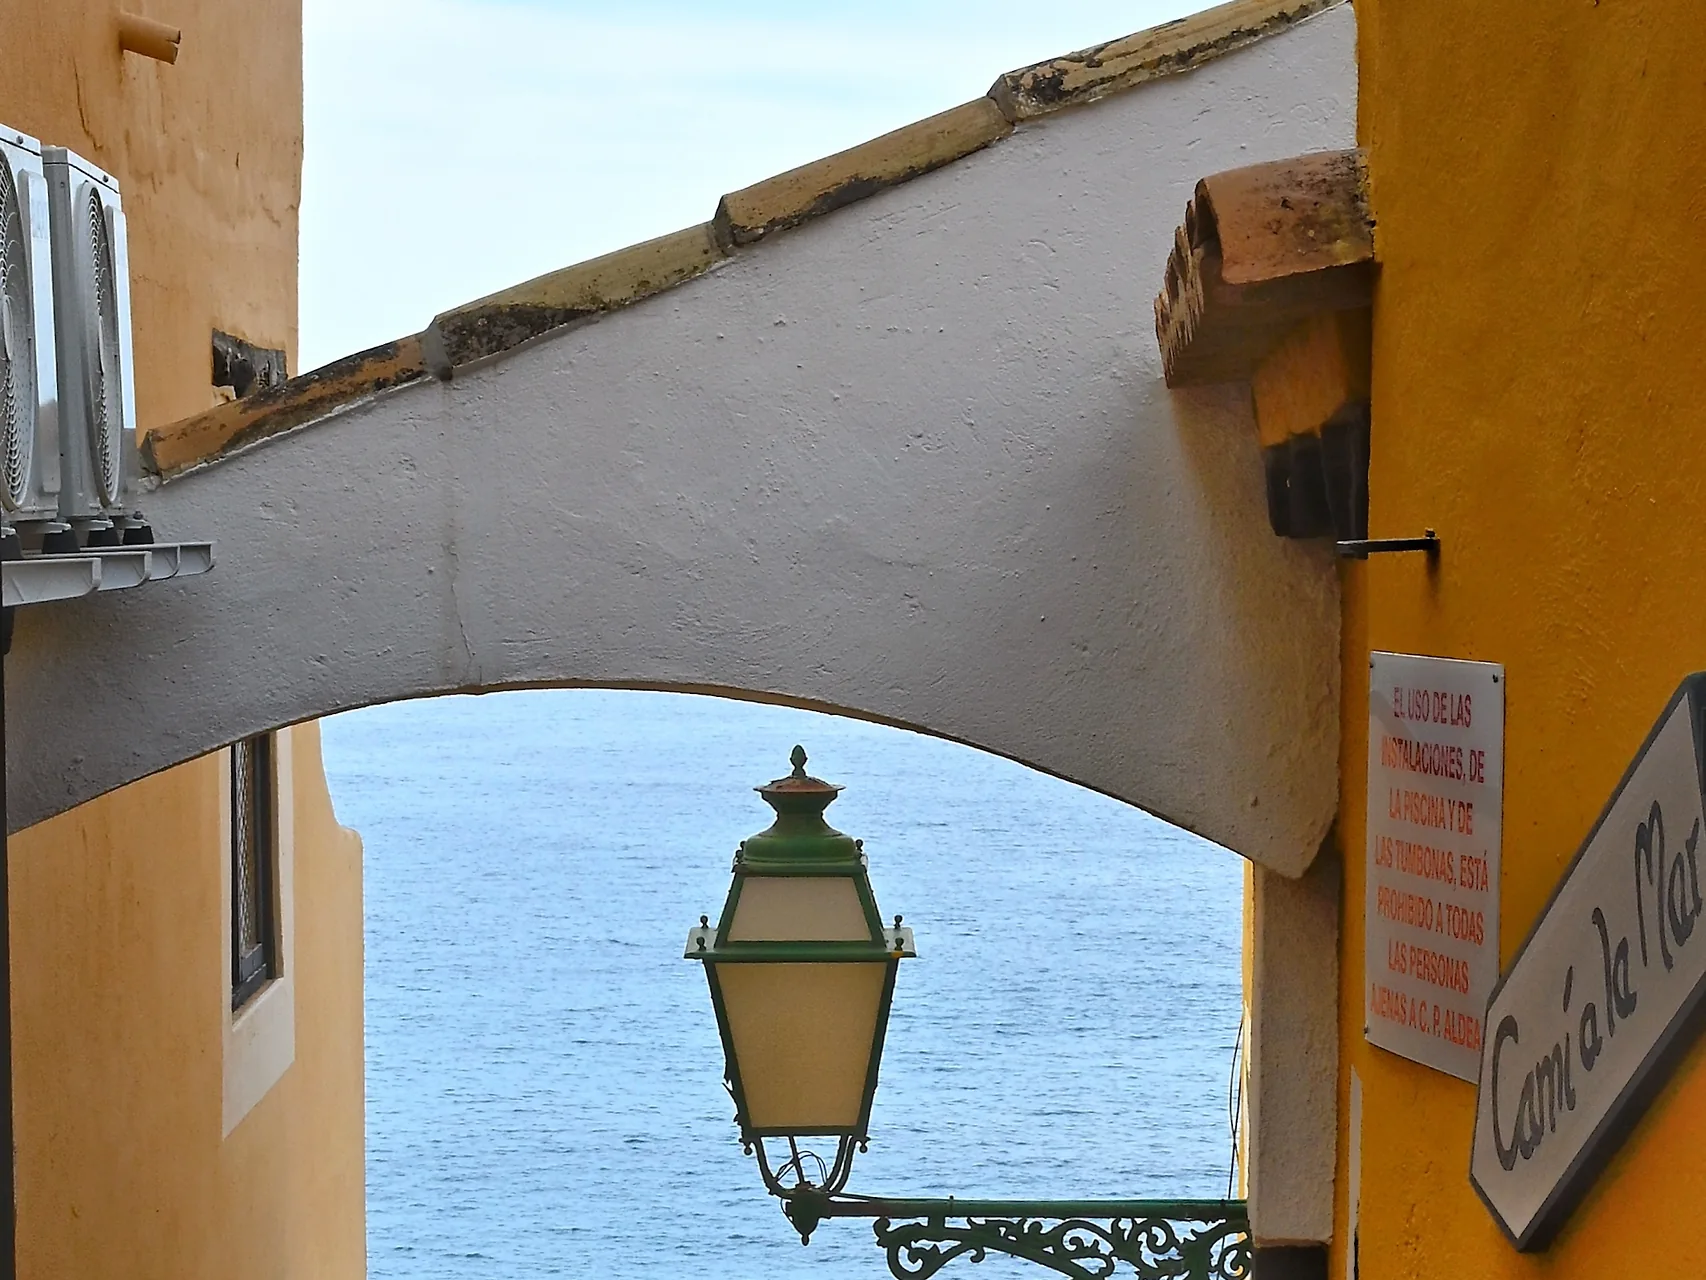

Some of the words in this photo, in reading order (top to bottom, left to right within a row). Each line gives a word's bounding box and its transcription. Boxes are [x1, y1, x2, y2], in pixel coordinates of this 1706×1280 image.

[1393, 687, 1405, 718] EL
[1408, 688, 1430, 722] USO
[1433, 691, 1447, 724] DE
[1450, 693, 1472, 728] LAS
[1381, 736, 1466, 786] INSTALACIONES,
[1469, 750, 1485, 783] DE
[1389, 787, 1401, 819] LA
[1404, 790, 1446, 829] PISCINA
[1448, 799, 1455, 831] Y
[1458, 801, 1473, 835] DE
[1375, 835, 1392, 868] LAS
[1396, 840, 1457, 891] TUMBONAS,
[1460, 849, 1489, 892] ESTÁ
[1377, 885, 1433, 931] PROHIBIDO
[1435, 902, 1444, 934] A
[1446, 904, 1484, 946] TODAS
[1388, 938, 1407, 974] LAS
[1410, 945, 1469, 995] PERSONAS
[1492, 965, 1576, 1171] Camí
[1579, 1002, 1602, 1071] a
[1592, 907, 1637, 1038] la
[1635, 800, 1703, 972] Mar
[1409, 997, 1417, 1029] A
[1443, 1009, 1481, 1052] ALDEA
